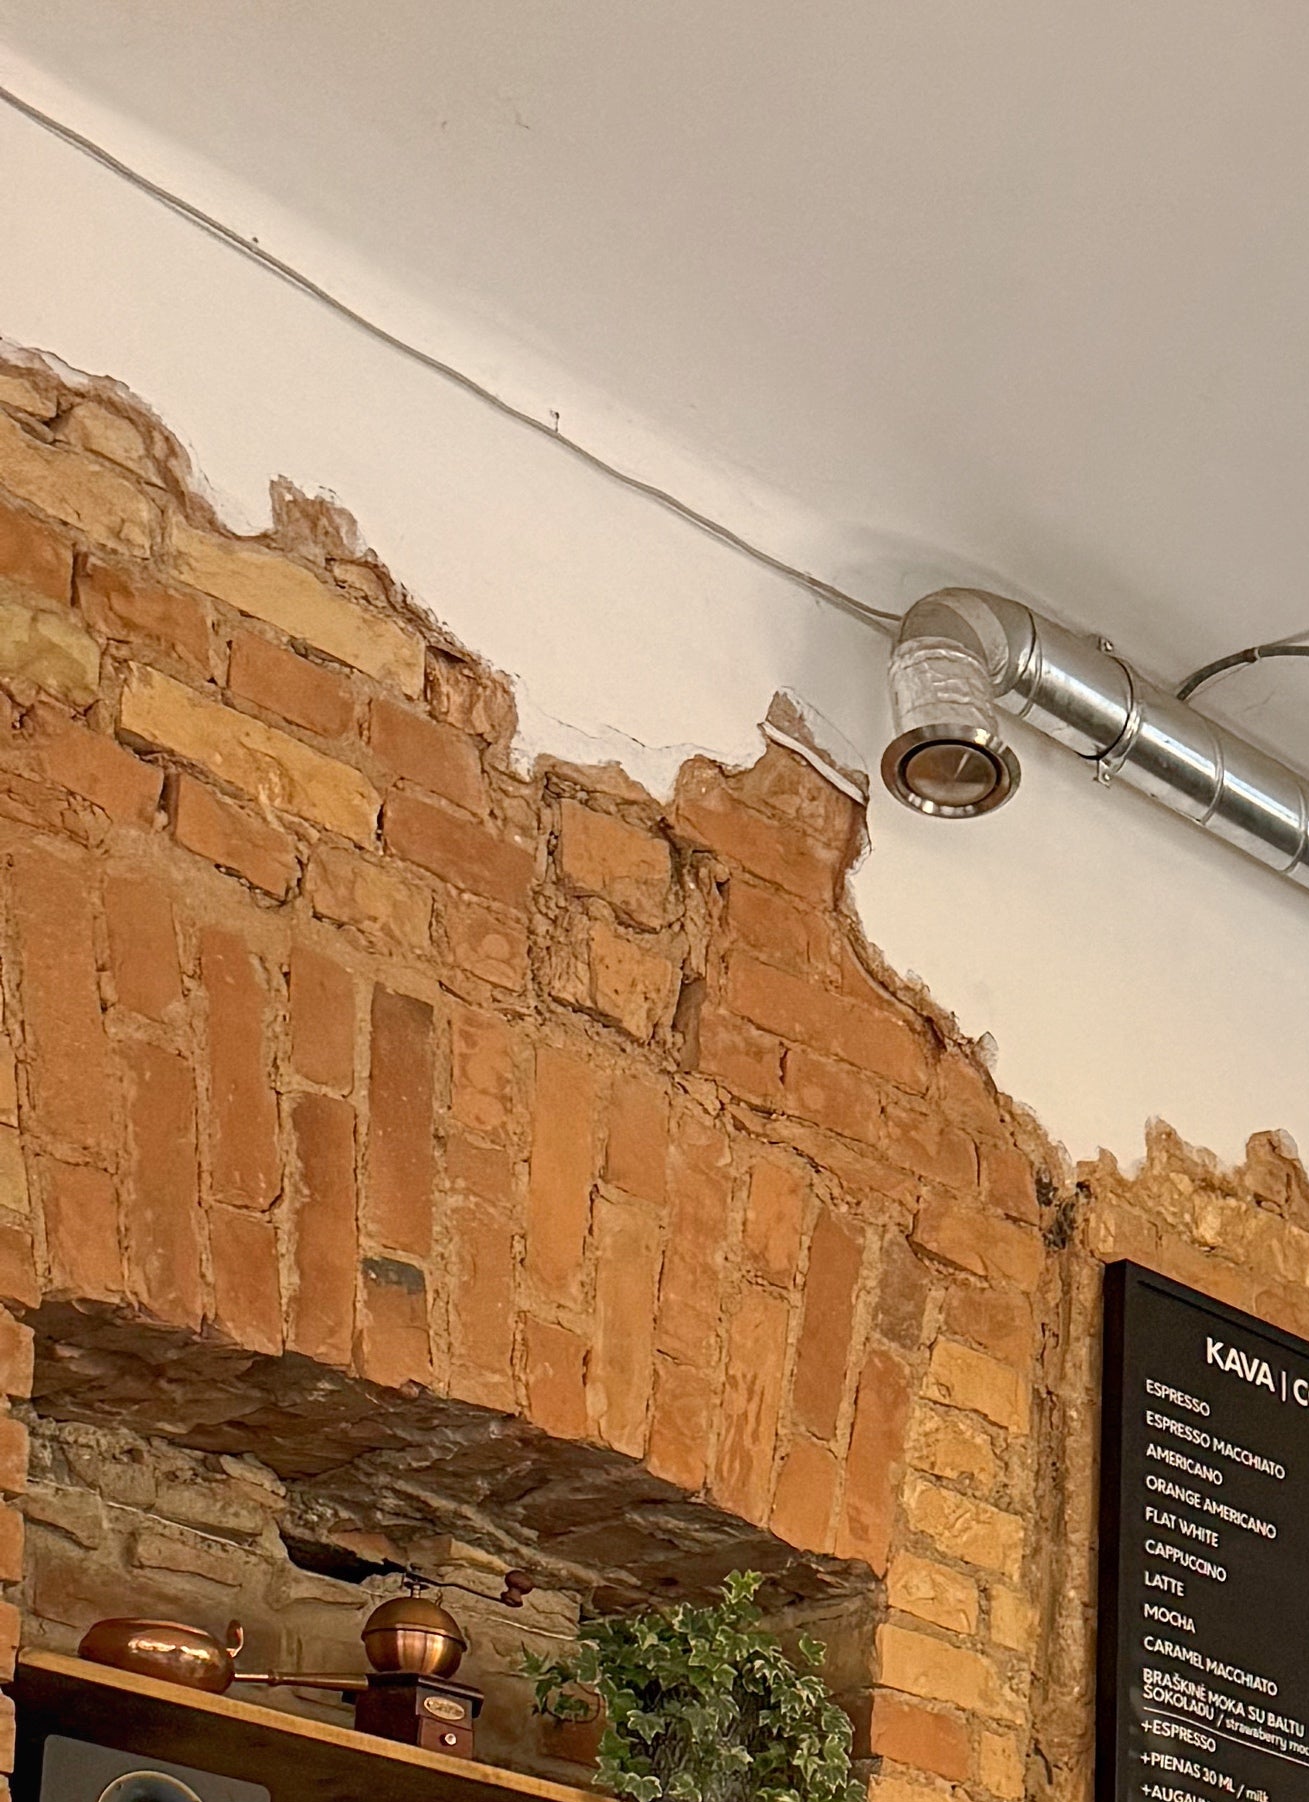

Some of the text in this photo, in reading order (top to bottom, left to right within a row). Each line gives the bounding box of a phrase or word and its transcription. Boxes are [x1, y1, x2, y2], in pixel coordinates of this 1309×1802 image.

[1206, 1336, 1276, 1393] KAVA
[1145, 1378, 1211, 1417] ESPRESSO
[1145, 1410, 1286, 1480] ESPRESSO MACCHIATO
[1146, 1443, 1223, 1486] AMERICANO
[1145, 1475, 1277, 1539] ORANGE AMERICANO
[1145, 1506, 1219, 1548] FLAT WHITE
[1145, 1539, 1227, 1582] CAPPUCCINO
[1145, 1571, 1185, 1597] LATTE
[1143, 1603, 1196, 1634] MOCHA
[1143, 1636, 1278, 1697] CARAMEL MACCHIATO
[1142, 1667, 1305, 1738] BRAŠKINĖ MOKA SU BALTU
[1142, 1685, 1214, 1721] ŠOKOLADU
[1141, 1719, 1216, 1753] +ESPRESSO
[1140, 1752, 1201, 1778] +PIENAS
[1202, 1767, 1217, 1785] 30
[1218, 1774, 1235, 1793] ML
